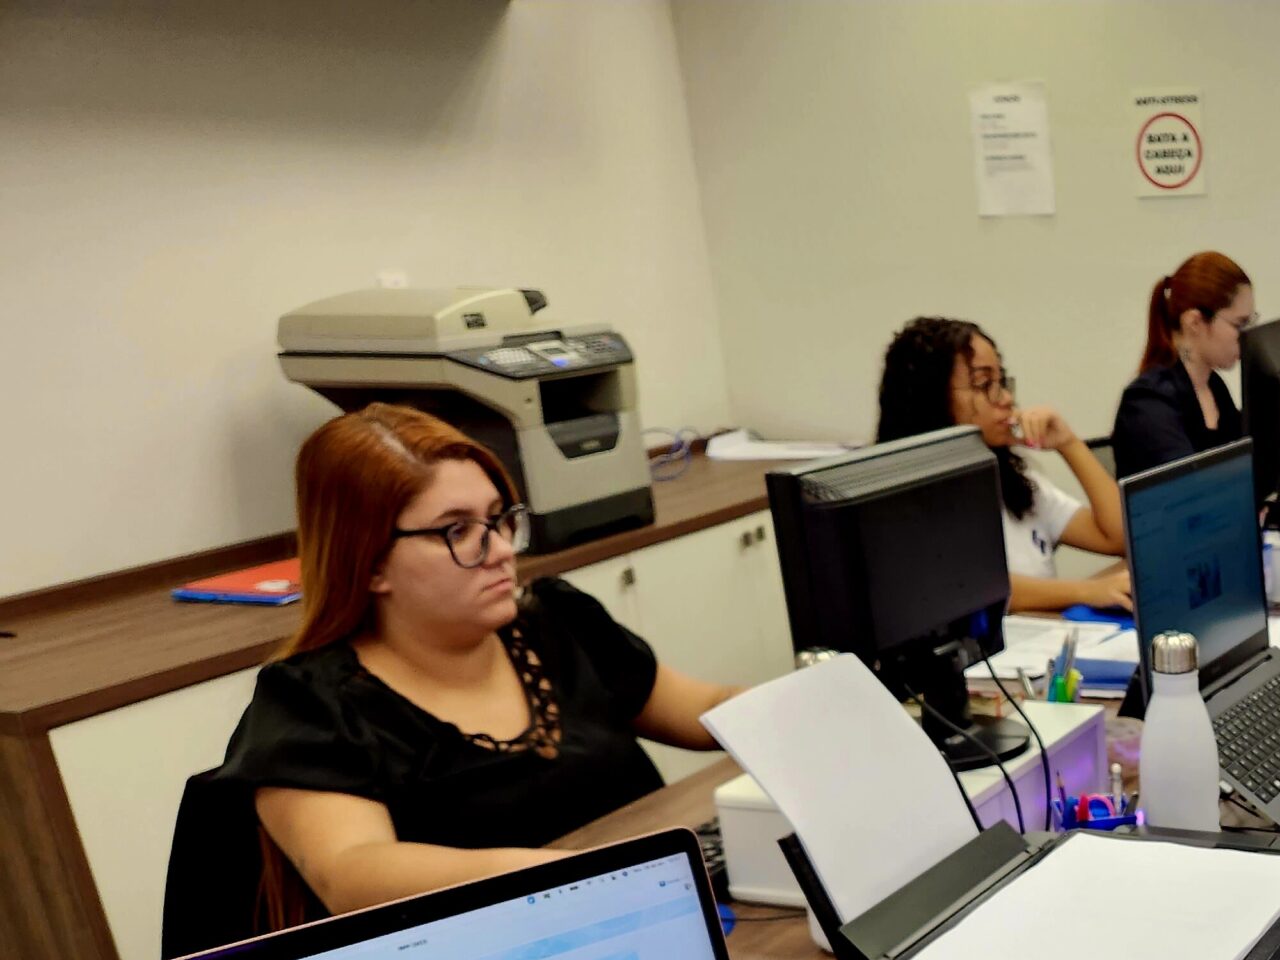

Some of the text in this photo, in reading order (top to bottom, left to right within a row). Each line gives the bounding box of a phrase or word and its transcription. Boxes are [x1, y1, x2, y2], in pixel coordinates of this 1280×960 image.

[1148, 133, 1189, 143] BATA A
[1146, 148, 1192, 160] CABEÇA
[1156, 165, 1184, 175] AQUI
